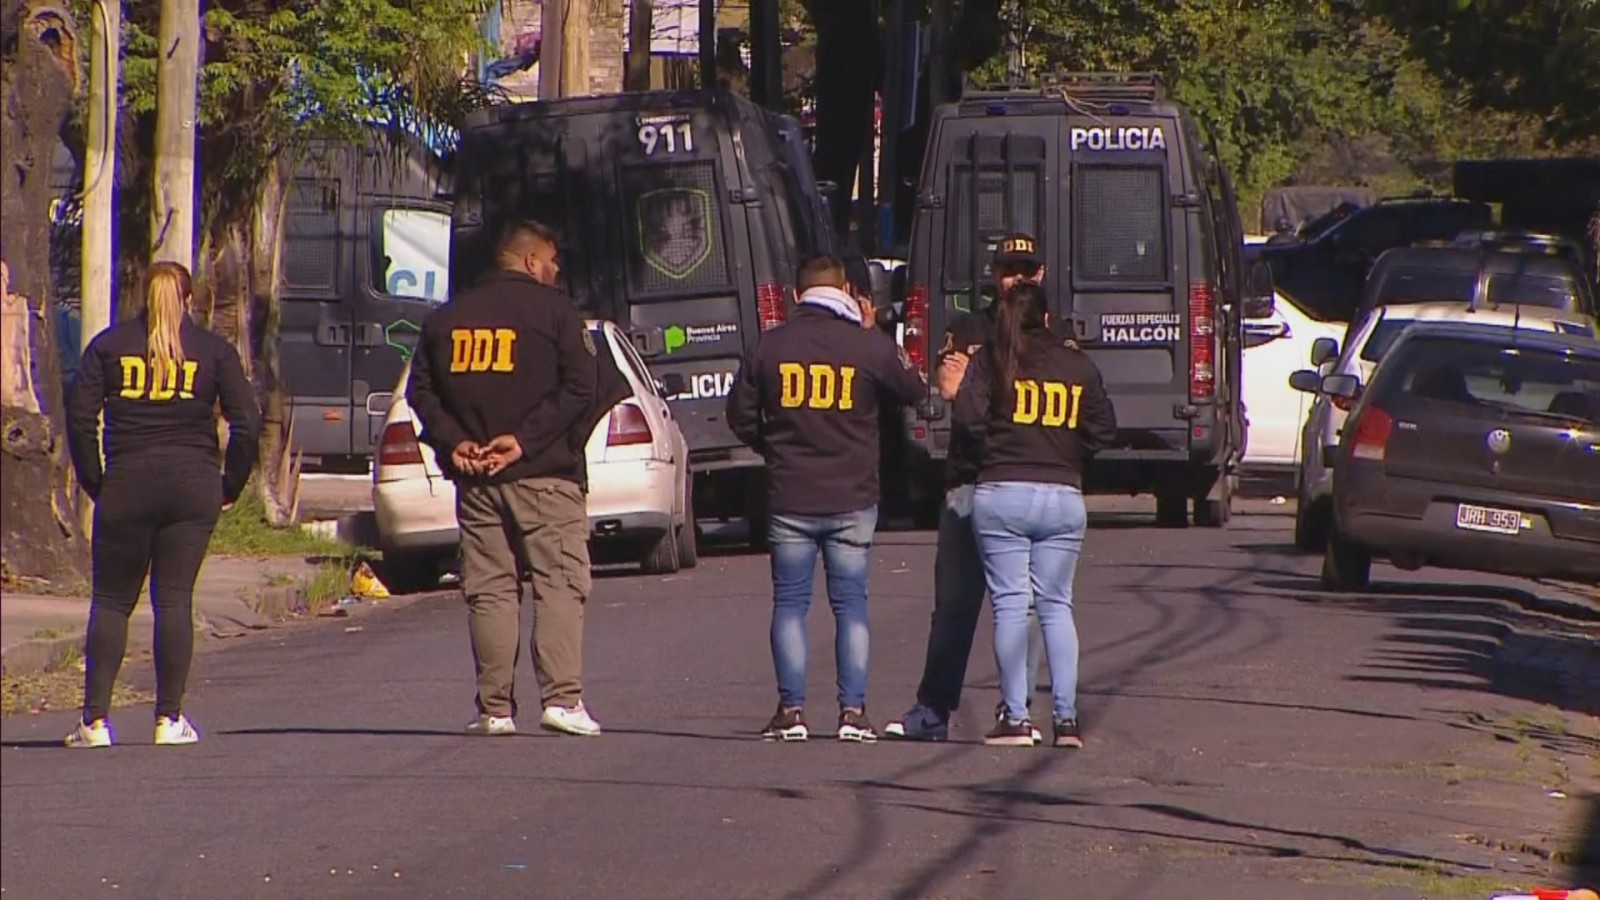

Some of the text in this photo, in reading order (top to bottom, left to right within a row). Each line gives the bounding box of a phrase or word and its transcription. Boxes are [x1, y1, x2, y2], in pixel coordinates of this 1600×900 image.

[638, 123, 693, 155] 911
[1071, 127, 1166, 151] POLICIA
[1003, 239, 1035, 253] DDI
[716, 324, 737, 332] Aires
[1102, 314, 1135, 325] FUERZAS
[1102, 325, 1180, 342] HALCÓN
[451, 328, 517, 372] DDI
[120, 356, 198, 400] DDI
[780, 363, 855, 410] DDI
[1013, 380, 1083, 429] DDI
[1460, 506, 1486, 525] JRH
